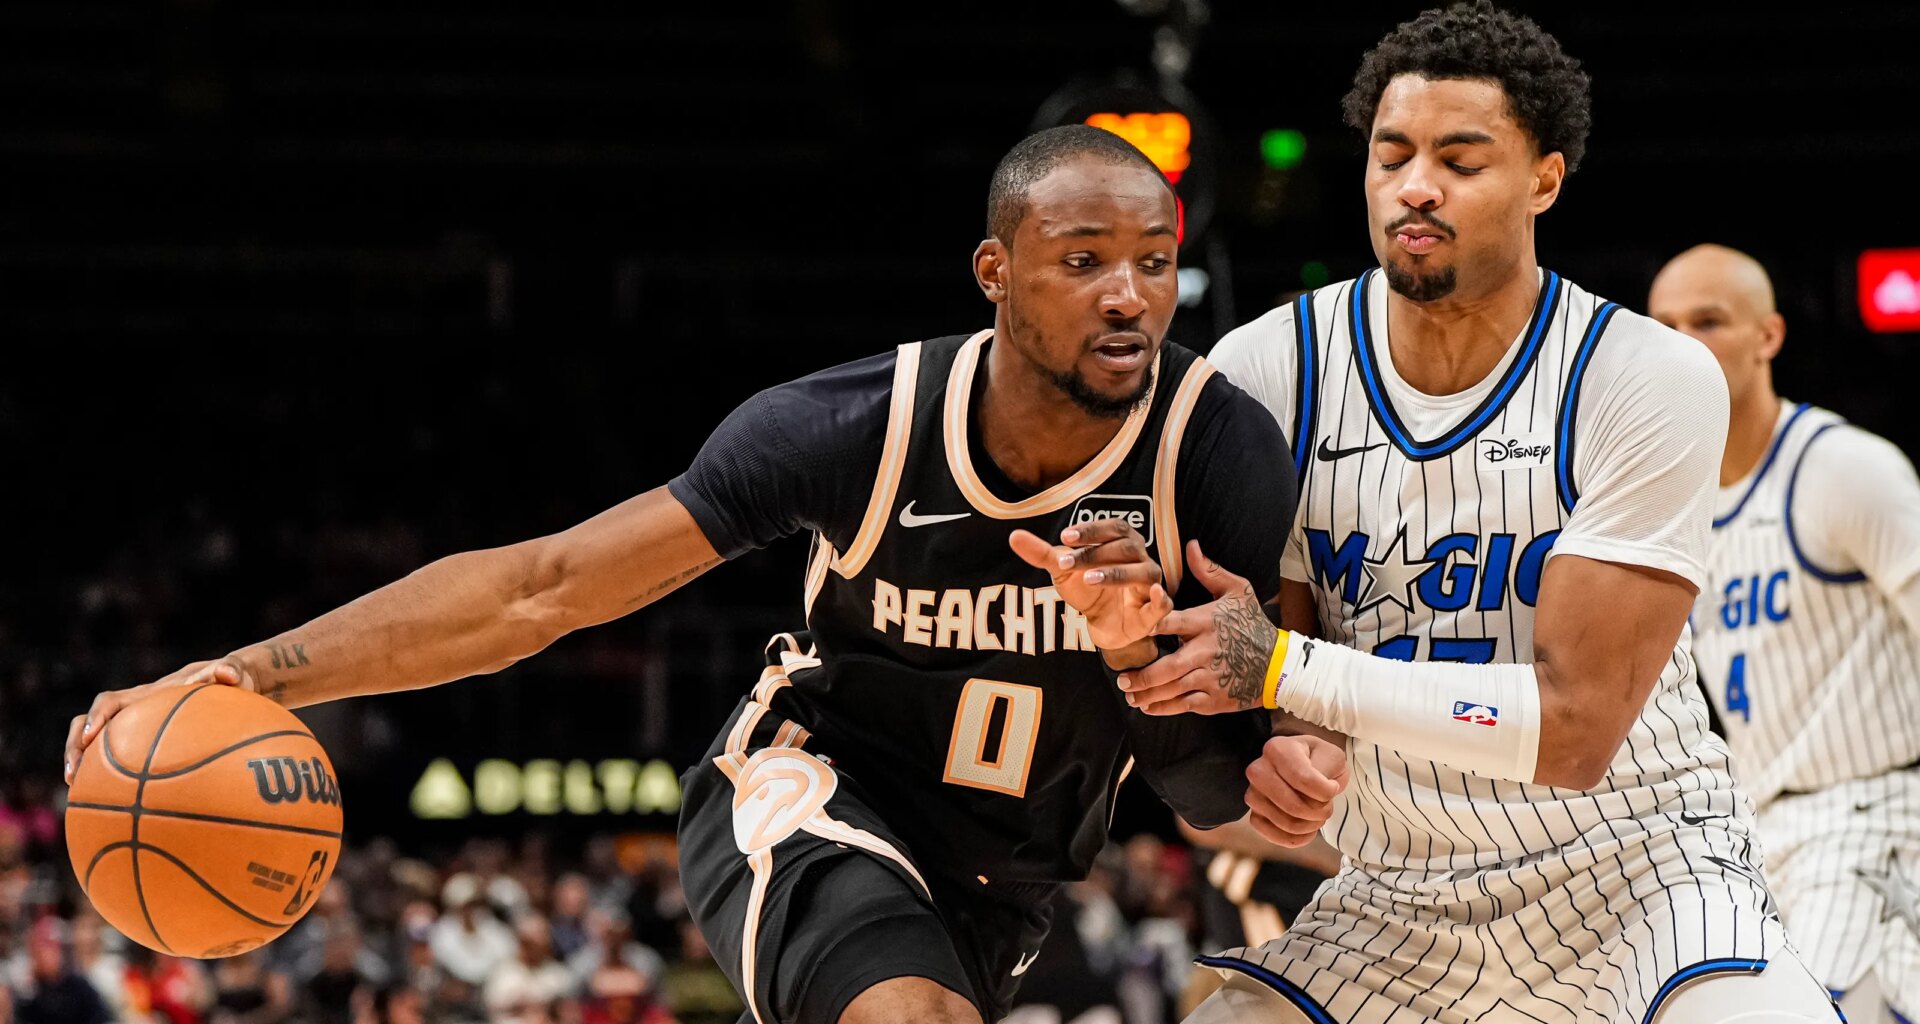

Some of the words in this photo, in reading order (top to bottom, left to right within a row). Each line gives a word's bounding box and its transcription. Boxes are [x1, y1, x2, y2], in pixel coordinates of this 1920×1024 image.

[1302, 523, 1563, 615] MGIC
[871, 578, 1097, 656] PEACHTR
[1726, 654, 1749, 721] 4
[943, 678, 1042, 797] 0
[247, 756, 342, 807] Wils
[474, 758, 681, 815] DELTA
